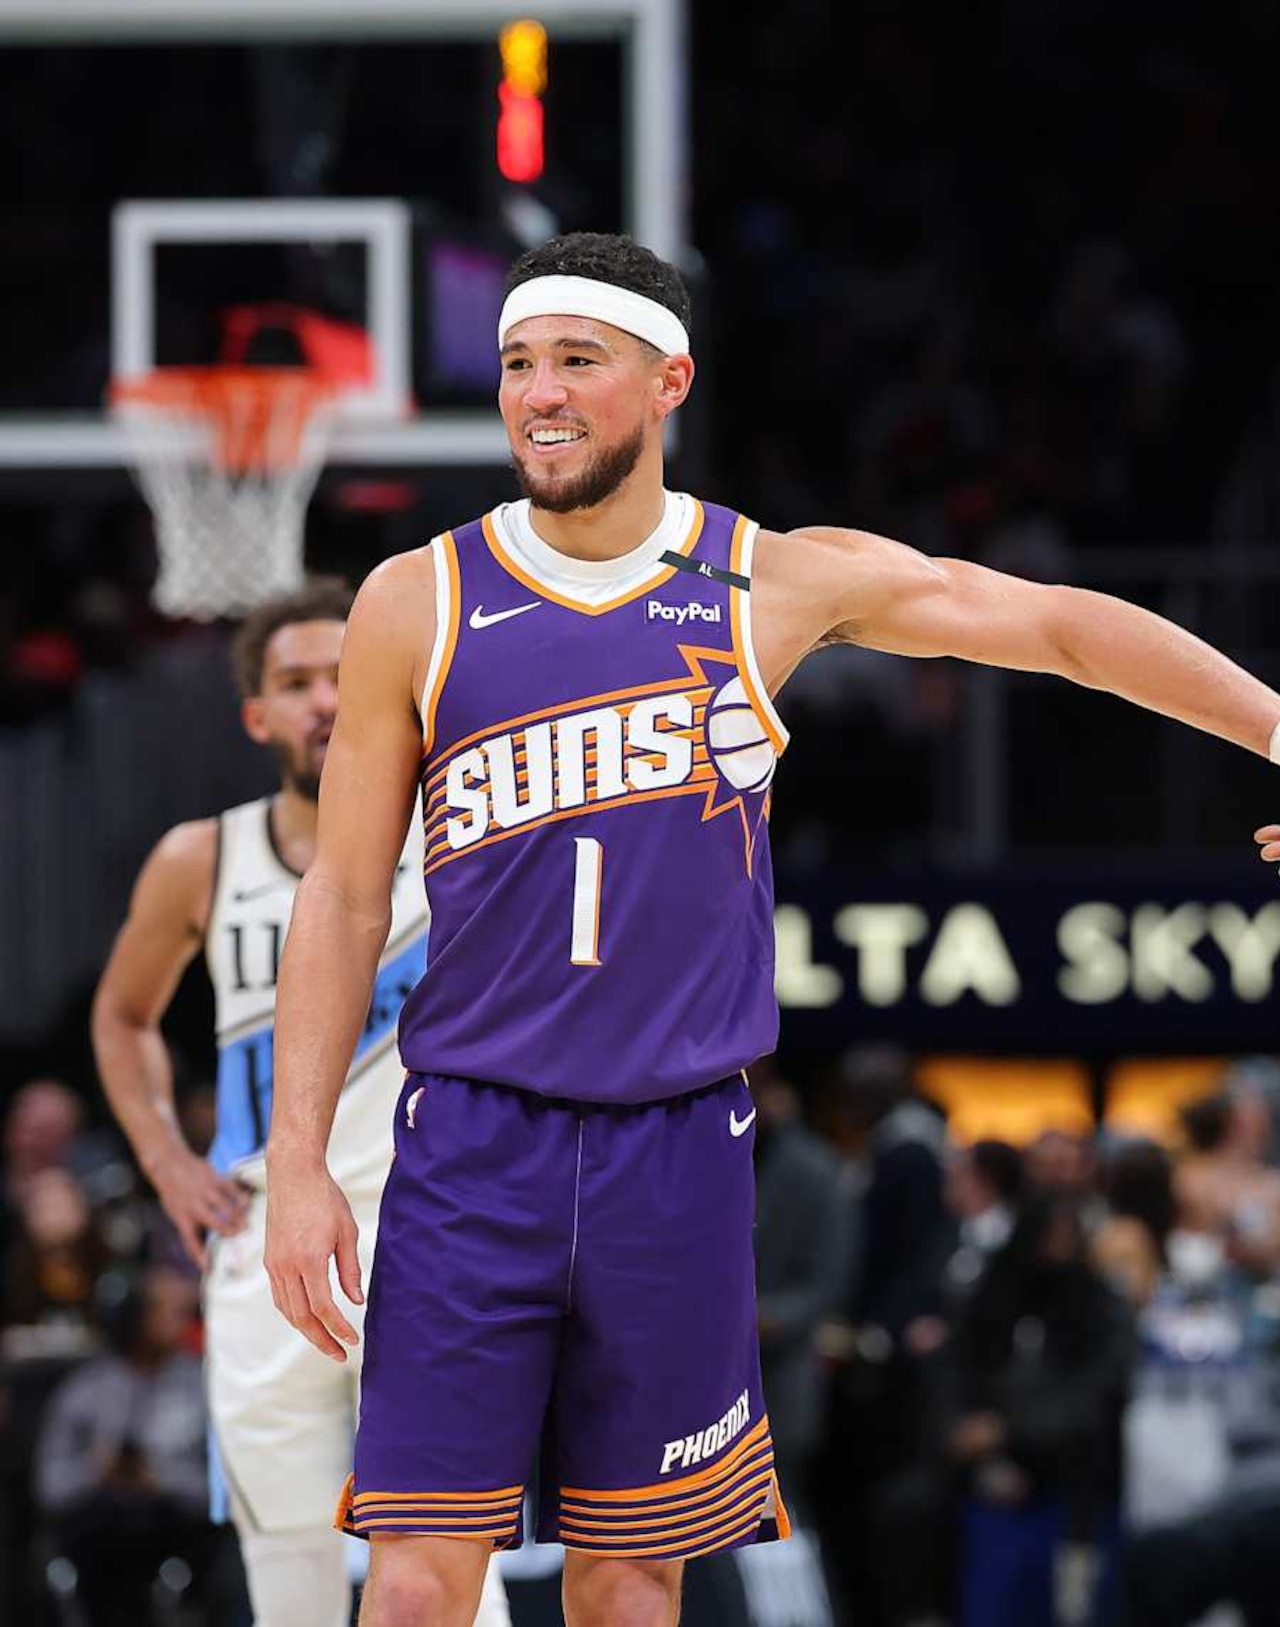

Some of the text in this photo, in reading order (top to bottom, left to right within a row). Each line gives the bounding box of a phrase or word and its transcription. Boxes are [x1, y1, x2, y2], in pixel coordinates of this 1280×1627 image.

[698, 562, 713, 578] AL
[648, 600, 721, 626] PayPal
[446, 694, 693, 851] SUNS
[570, 837, 602, 965] 1
[226, 923, 281, 990] 11
[659, 1388, 750, 1475] PHOENIX
